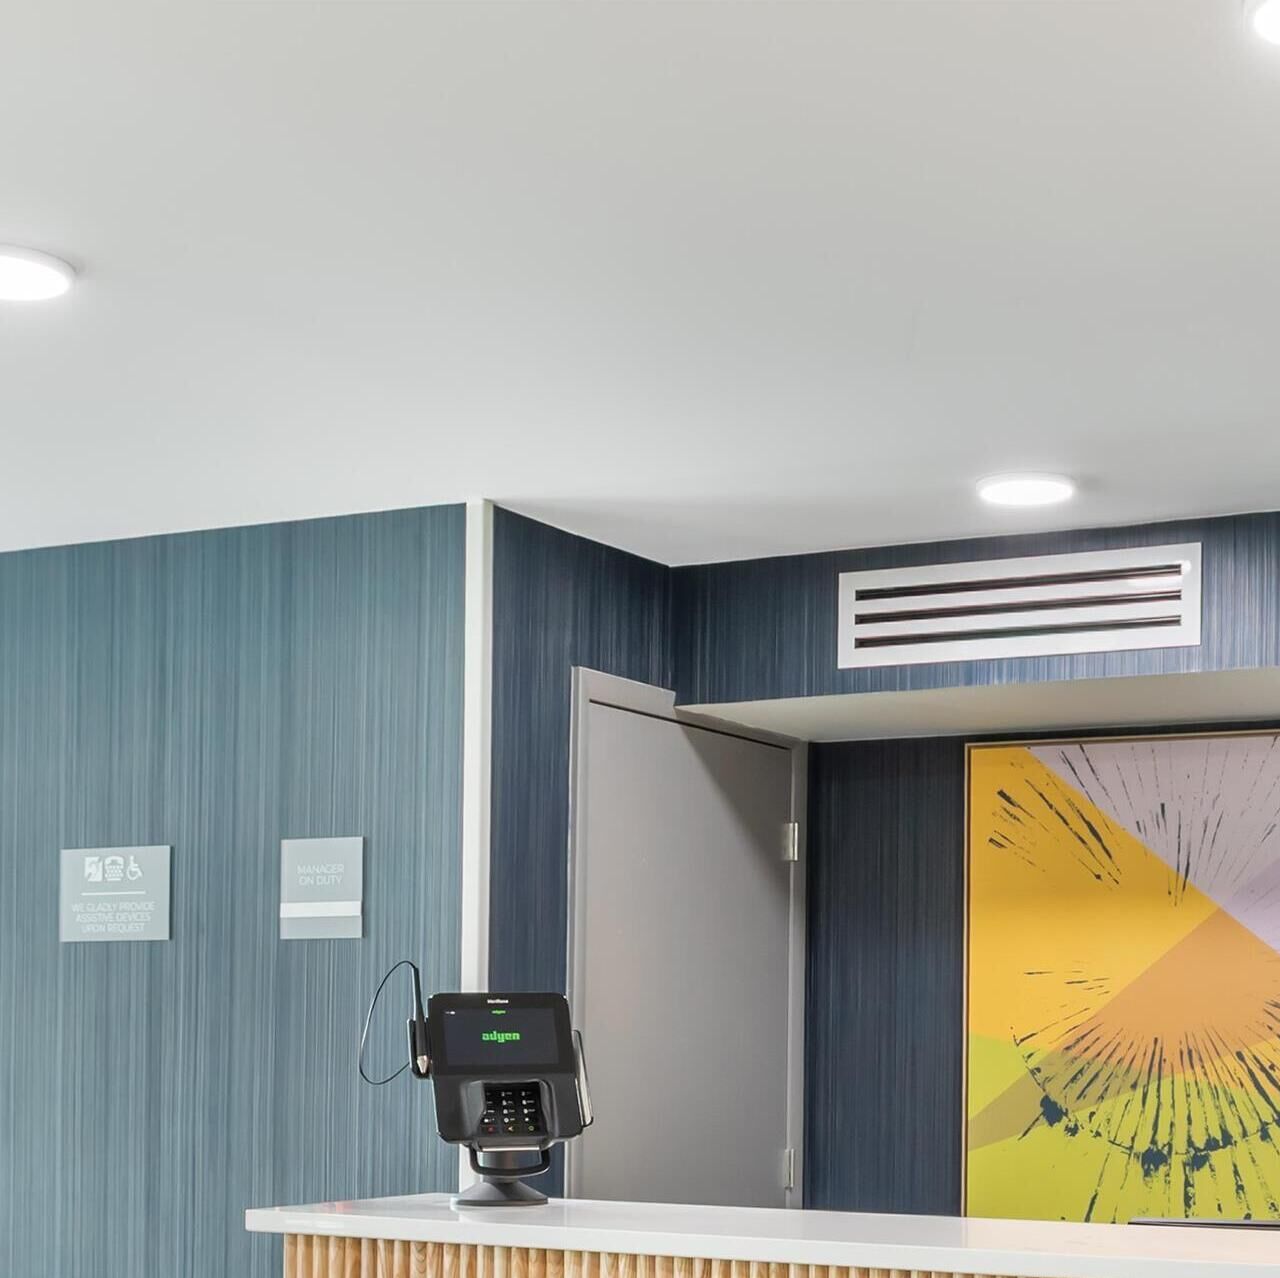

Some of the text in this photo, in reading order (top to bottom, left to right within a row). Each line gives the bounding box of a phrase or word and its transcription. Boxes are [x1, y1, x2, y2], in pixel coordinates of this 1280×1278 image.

[297, 864, 344, 874] MANAGER
[299, 874, 342, 886] ON DUTY
[482, 1030, 521, 1043] adyen
